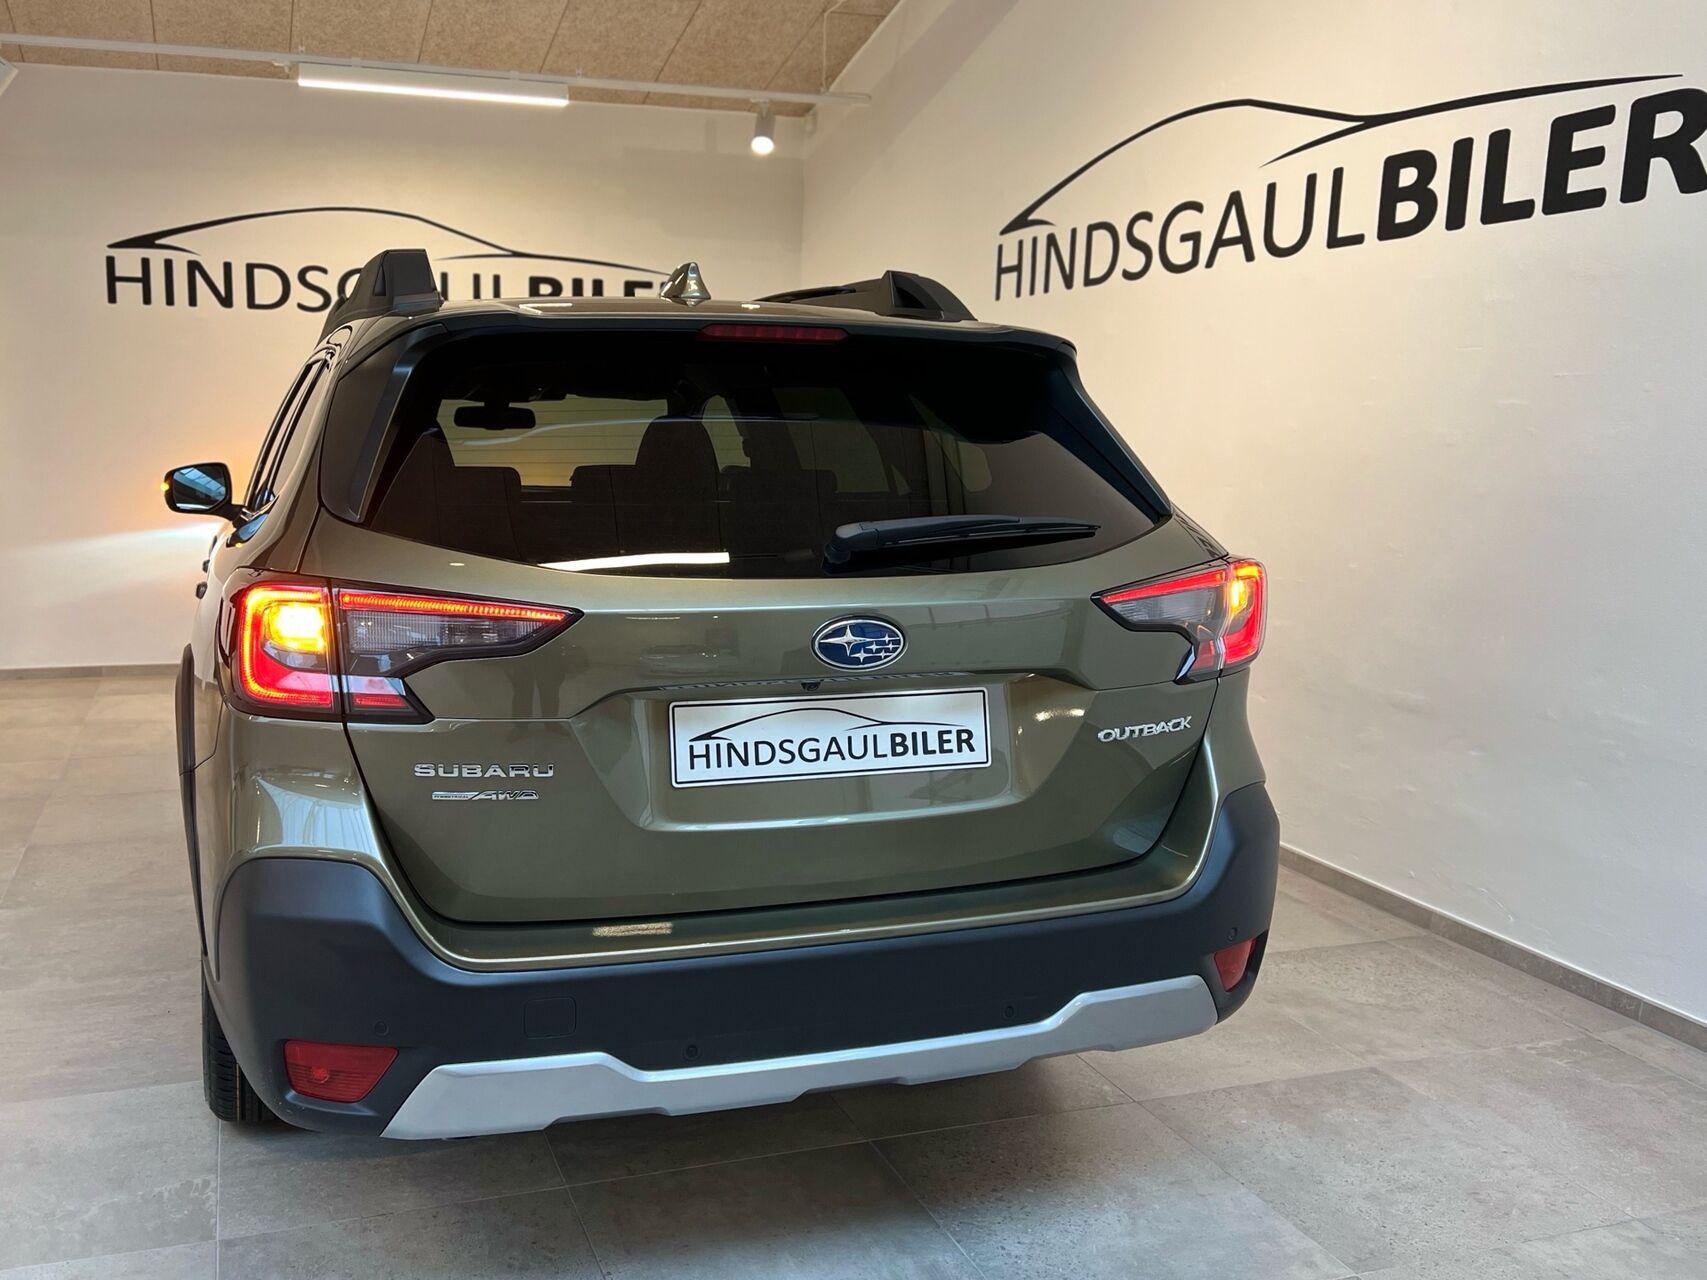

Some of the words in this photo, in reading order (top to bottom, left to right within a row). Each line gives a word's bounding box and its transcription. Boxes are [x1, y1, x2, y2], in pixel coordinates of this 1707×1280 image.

[995, 88, 1707, 301] HINDSGAULBILER
[1098, 716, 1192, 742] OUTBACK
[689, 729, 976, 770] HINDSGAULBILER
[414, 763, 554, 777] SUBARU
[471, 790, 539, 800] AWD
